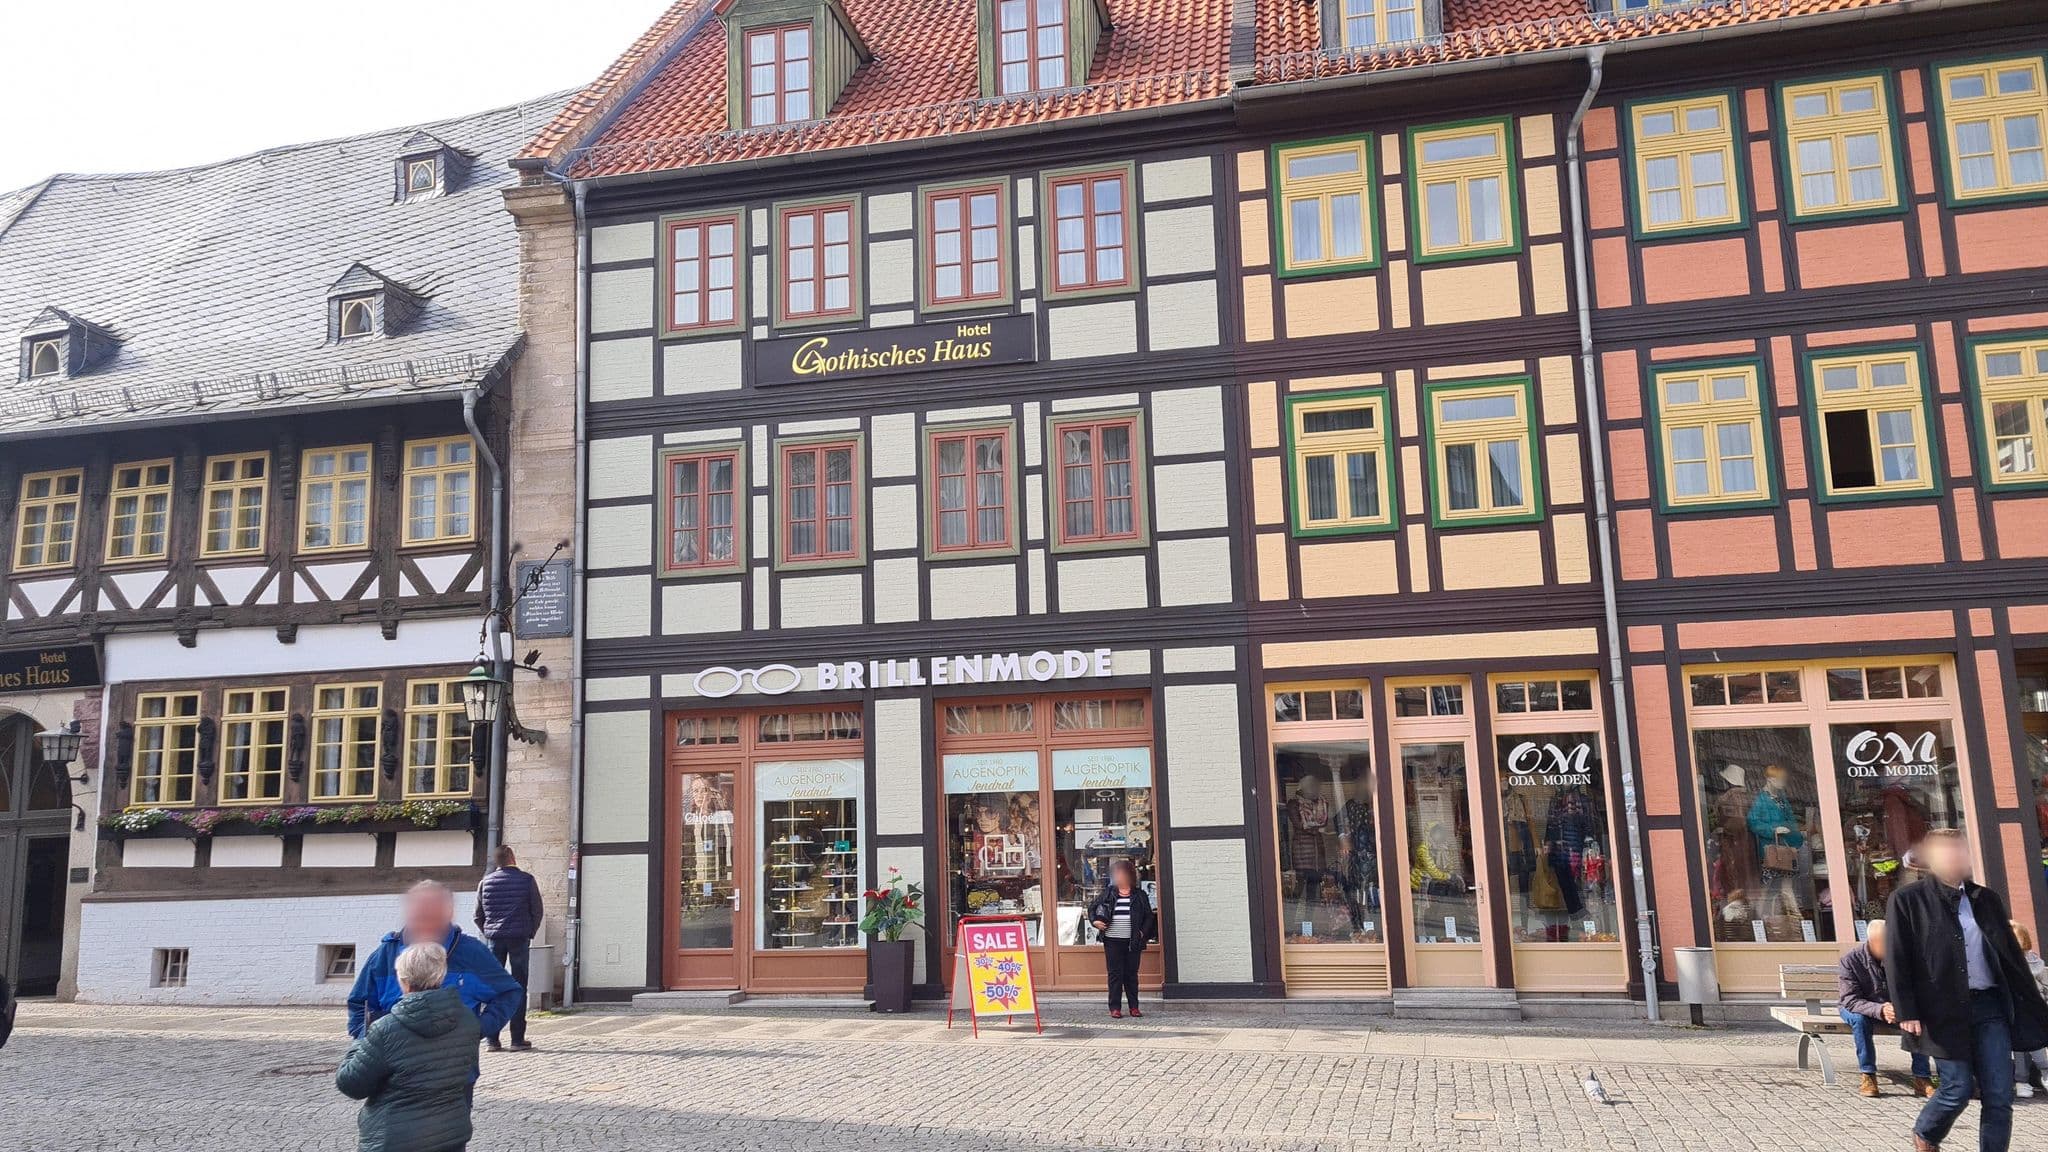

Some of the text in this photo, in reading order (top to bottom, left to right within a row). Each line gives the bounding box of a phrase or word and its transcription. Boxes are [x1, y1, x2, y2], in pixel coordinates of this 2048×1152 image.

[957, 323, 991, 338] Hotel
[792, 337, 992, 376] Gothisches Haus
[40, 651, 67, 664] Hotel
[25, 665, 70, 686] Haus
[817, 648, 1112, 690] BRILLENMODE
[953, 765, 1029, 779] AUGENOPTIK
[1063, 762, 1141, 775] AUGENOPTIK
[1847, 764, 1939, 778] ODA MODEN
[775, 772, 846, 786] AUGENOPTIK
[1508, 773, 1592, 786] ODA MODEN
[973, 932, 1018, 949] SALE
[998, 962, 1022, 972] 40%
[986, 984, 1019, 998] 50%
